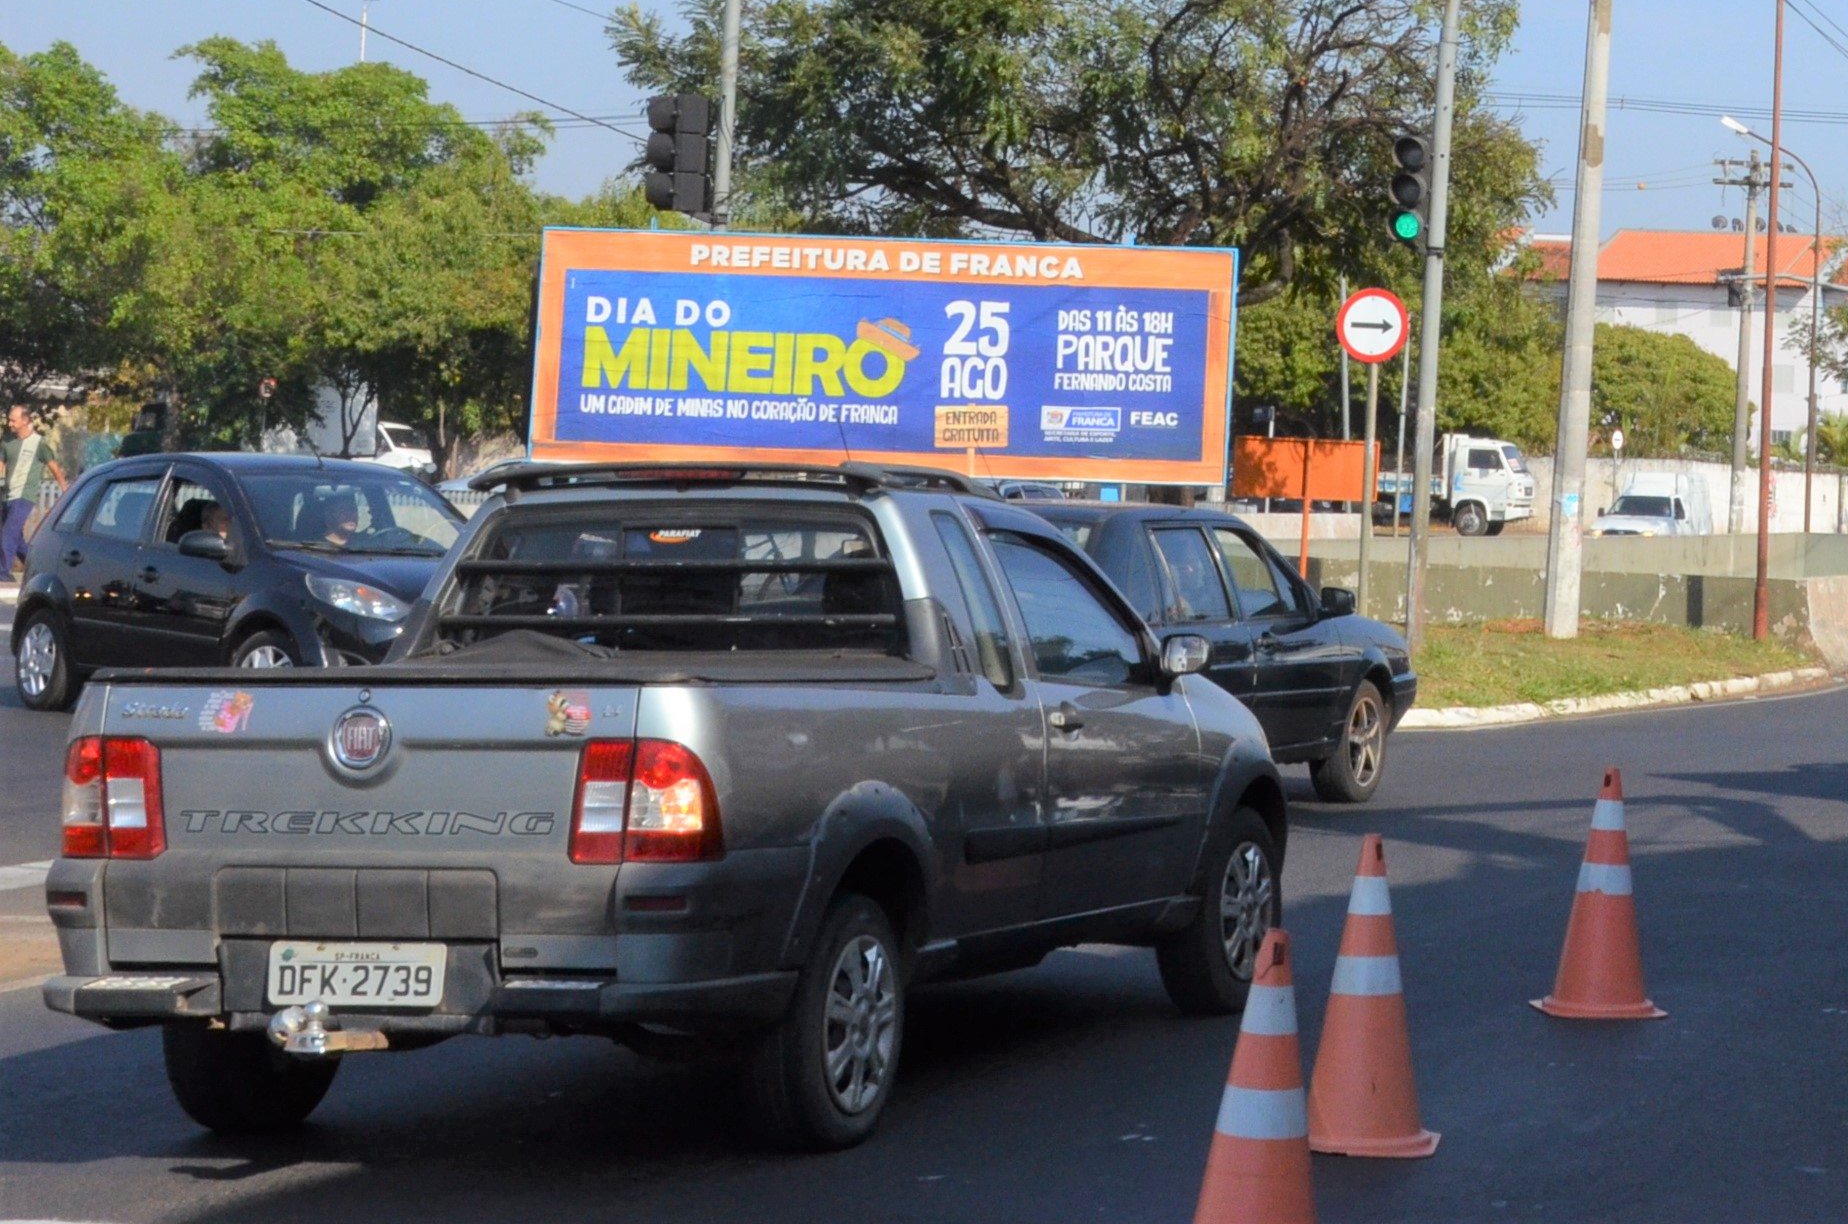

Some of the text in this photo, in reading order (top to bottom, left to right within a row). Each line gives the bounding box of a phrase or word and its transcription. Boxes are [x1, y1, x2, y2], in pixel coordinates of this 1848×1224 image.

[691, 244, 1084, 279] PREFEITURA DE FRANCA
[586, 296, 731, 327] DIA DO
[1058, 305, 1173, 334] DAS 11 ÀS 18H
[943, 300, 1010, 357] 25
[581, 326, 906, 398] MINEIRO
[1056, 335, 1173, 373] PARQUE
[940, 356, 1008, 400] AGO
[1054, 373, 1172, 393] FERNANDO COSTA
[580, 394, 897, 425] UM CADIM DE MINAS NO CORAÇÃO DE FRANCA
[945, 411, 997, 425] ENTRADA
[1072, 417, 1115, 426] FRANCA
[1130, 411, 1178, 426] FEAC
[943, 428, 999, 443] GRATUITA
[658, 529, 702, 538] PARAFIAT
[348, 726, 376, 751] FIAT
[181, 811, 554, 835] TREKKING
